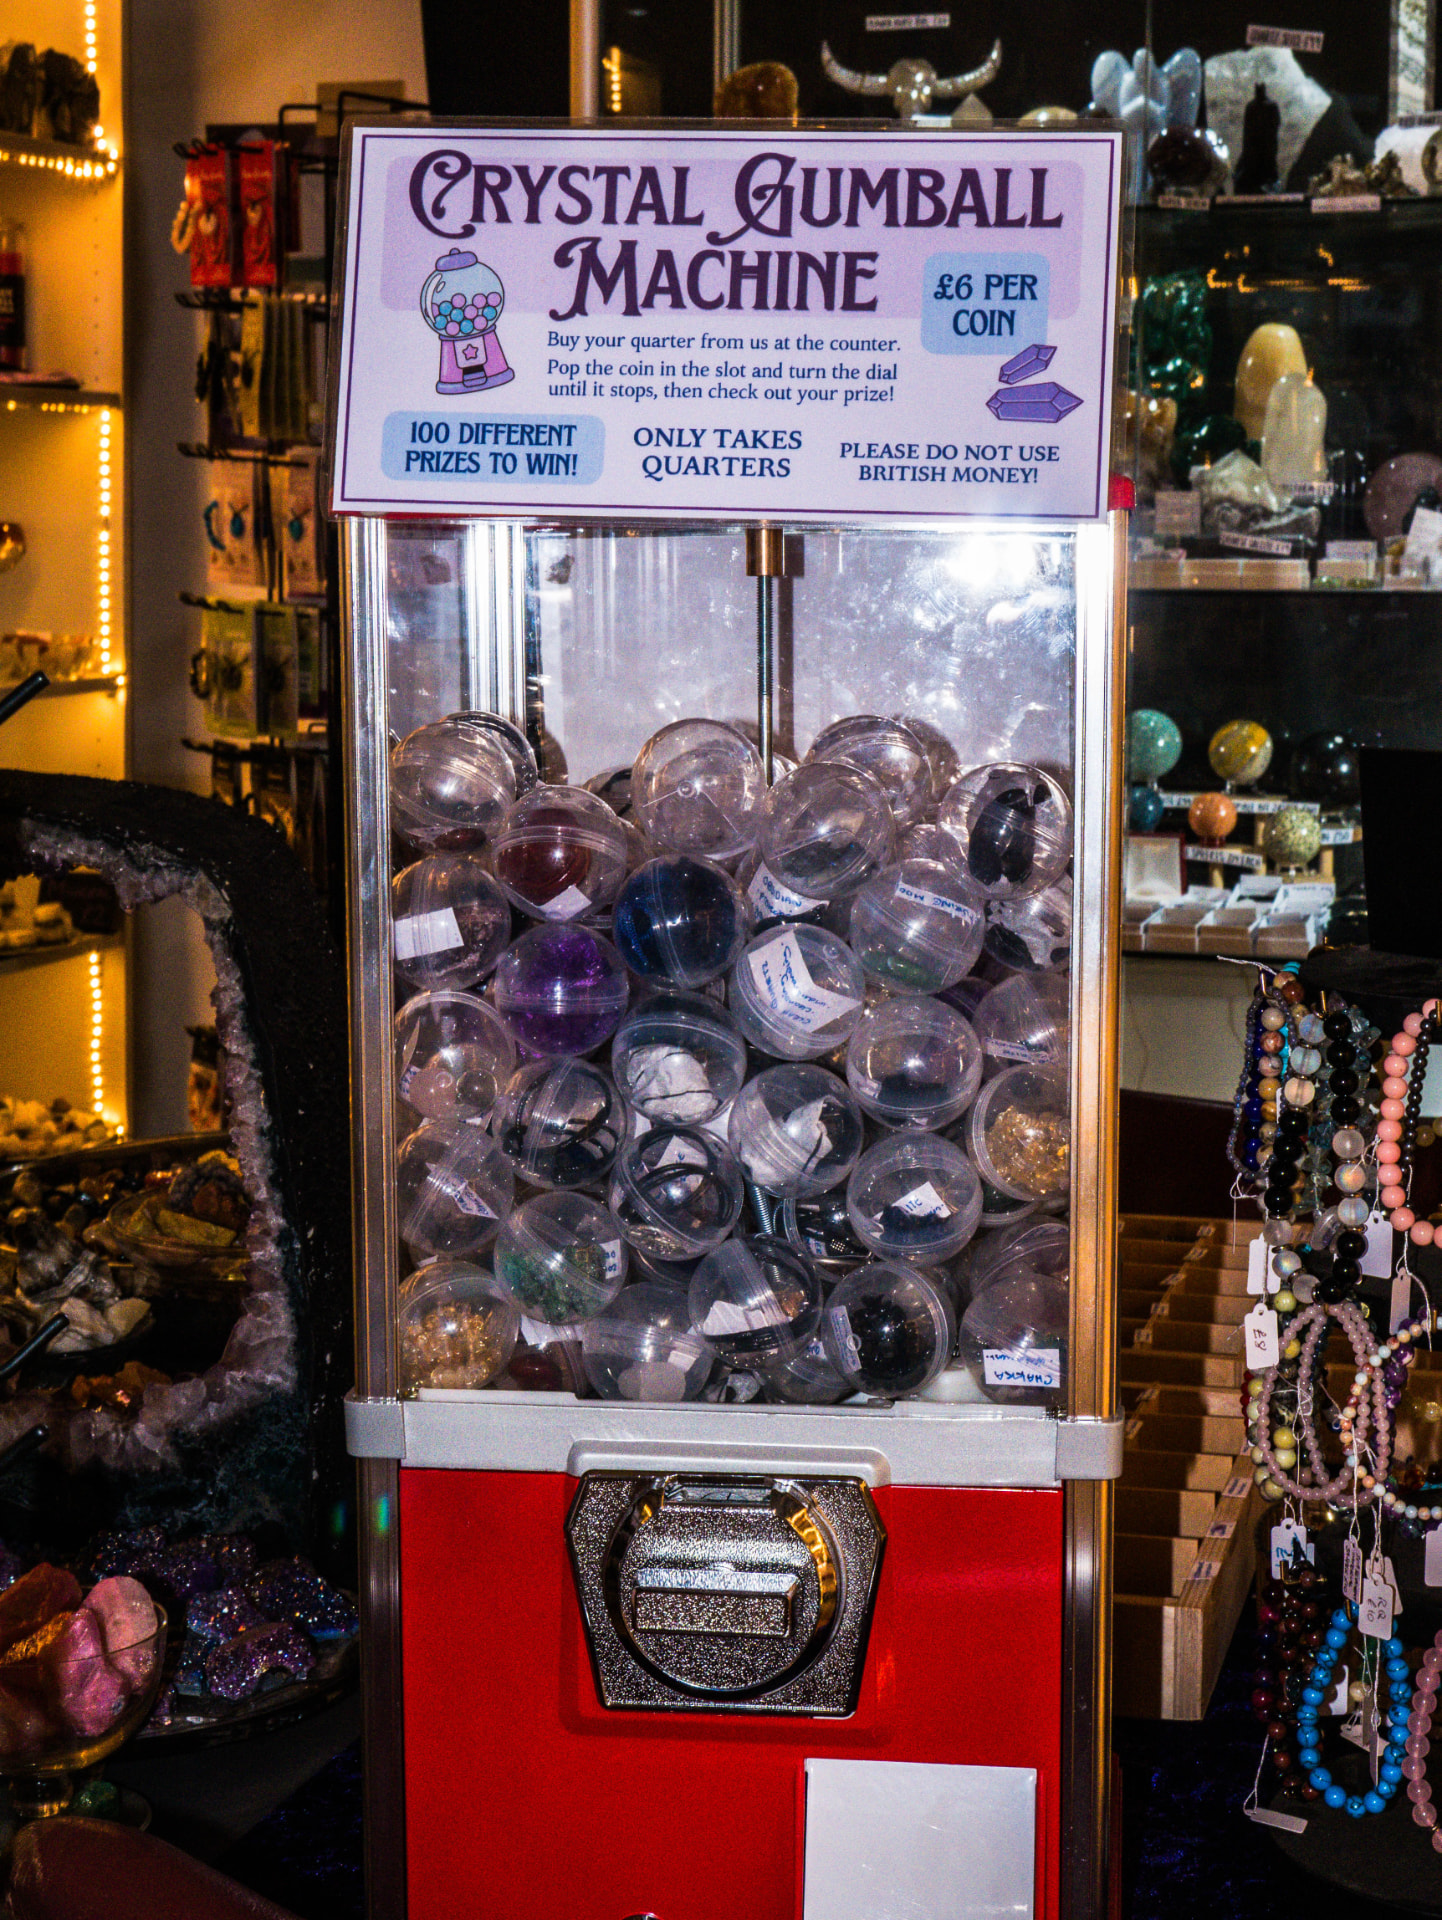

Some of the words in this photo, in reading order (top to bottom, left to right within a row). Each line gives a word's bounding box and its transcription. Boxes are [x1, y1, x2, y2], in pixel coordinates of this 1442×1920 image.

[408, 149, 705, 240] CRYSTAL
[705, 152, 1064, 247] GUMBALL
[548, 236, 880, 323] MACHINE
[932, 273, 974, 301] £6
[984, 273, 1039, 301] PER
[952, 308, 1016, 337] COIN
[547, 330, 581, 353] Buy
[583, 335, 626, 353] your
[630, 335, 696, 354] quarter
[700, 332, 744, 350] from
[749, 338, 769, 351] us
[773, 337, 791, 351] at
[795, 333, 825, 351] the
[829, 338, 901, 352] counter.
[547, 358, 581, 381] Pop
[585, 358, 614, 376] the
[618, 360, 655, 377] coin
[659, 360, 676, 377] in
[681, 359, 710, 378] the
[715, 360, 747, 378] slot
[751, 361, 783, 379] and
[788, 365, 827, 380] turn
[831, 362, 861, 380] the
[865, 362, 898, 381] dial
[548, 379, 587, 397] until
[592, 380, 605, 397] it
[610, 384, 658, 403] stops,
[663, 381, 703, 399] then
[707, 382, 759, 400] check
[763, 386, 792, 401] out
[796, 388, 839, 406] your
[843, 385, 894, 407] prize!
[410, 420, 451, 444] 100
[458, 421, 578, 447] DIFFERENT
[633, 426, 708, 449] ONLY
[712, 428, 803, 451] TAKES
[404, 449, 481, 475] PRIZES
[488, 451, 518, 475] TO
[525, 453, 579, 477] WIN!
[839, 442, 920, 460] PLEASE
[925, 443, 959, 461] DO
[964, 444, 1014, 462] NOT
[1018, 445, 1060, 462] USE
[641, 454, 791, 483] QUARTERS
[858, 464, 947, 483] BRITISH
[951, 466, 1039, 484] MONEY!
[761, 960, 779, 1010] QUARTZ
